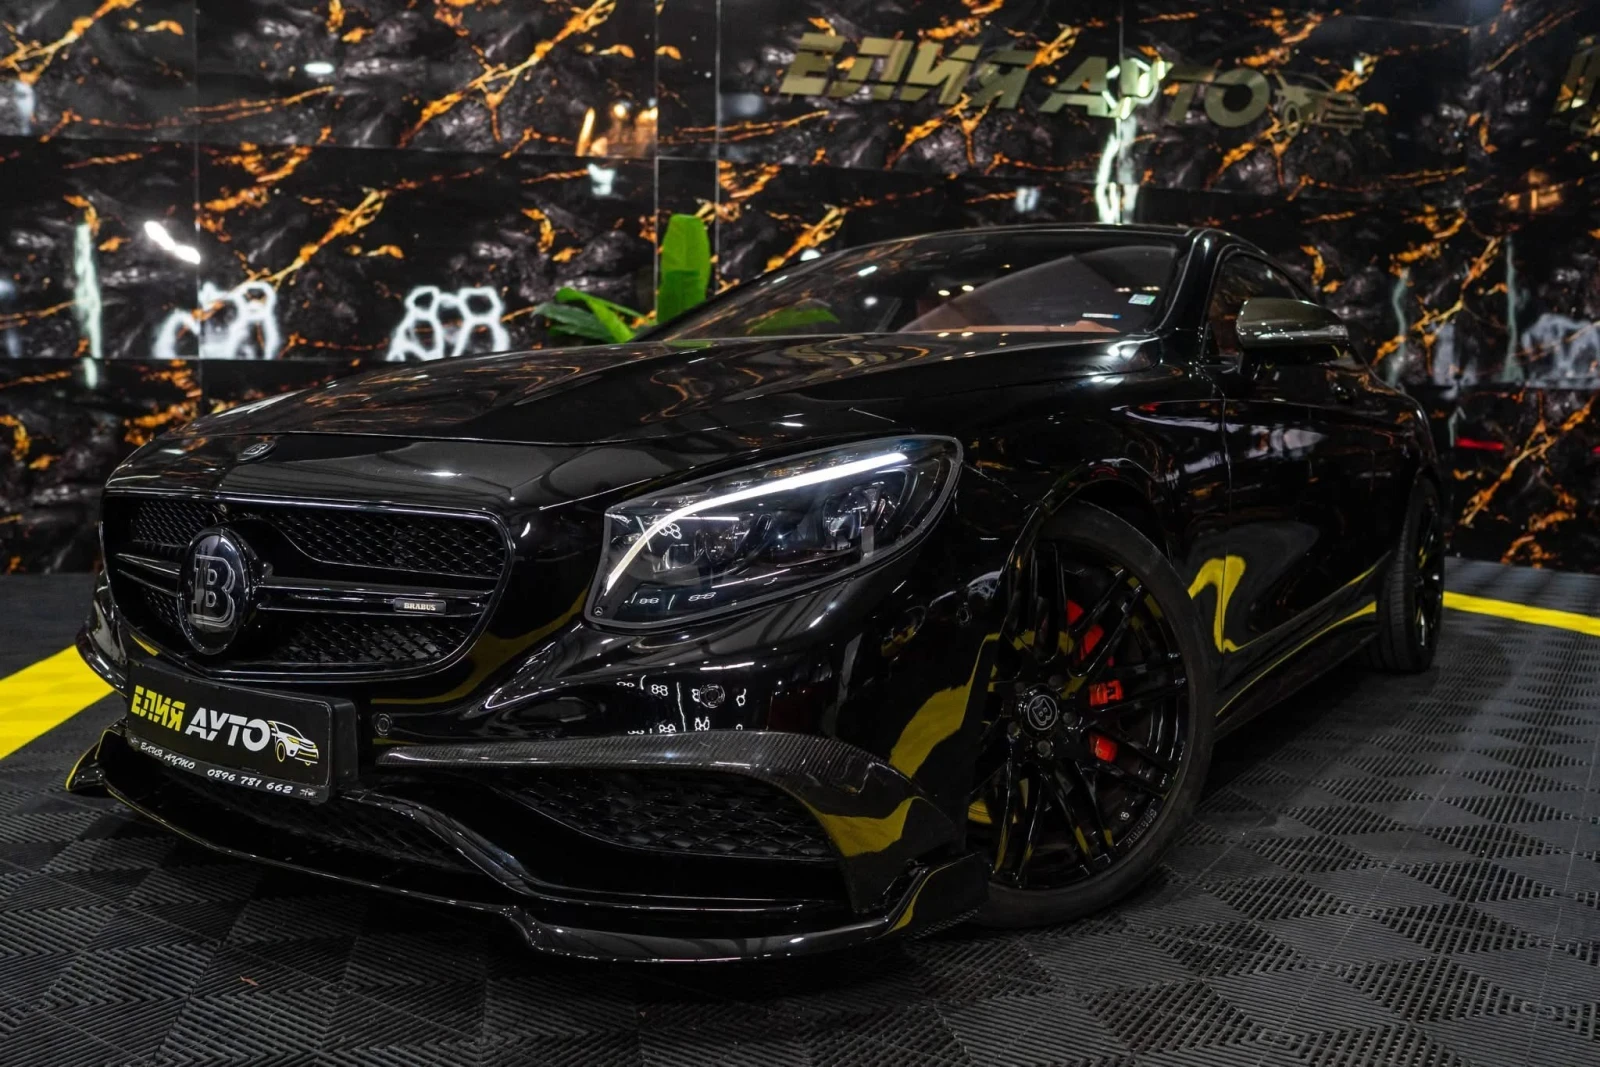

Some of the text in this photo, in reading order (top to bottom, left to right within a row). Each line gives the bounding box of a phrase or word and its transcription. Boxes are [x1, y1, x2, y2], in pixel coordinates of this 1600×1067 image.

[780, 33, 1269, 127] ЕЛИЯ АУТО
[193, 554, 236, 627] B
[403, 602, 436, 611] BRABUS
[131, 685, 270, 751] ЕЛИЯ АУТО
[207, 769, 293, 794] 0896 781 662
